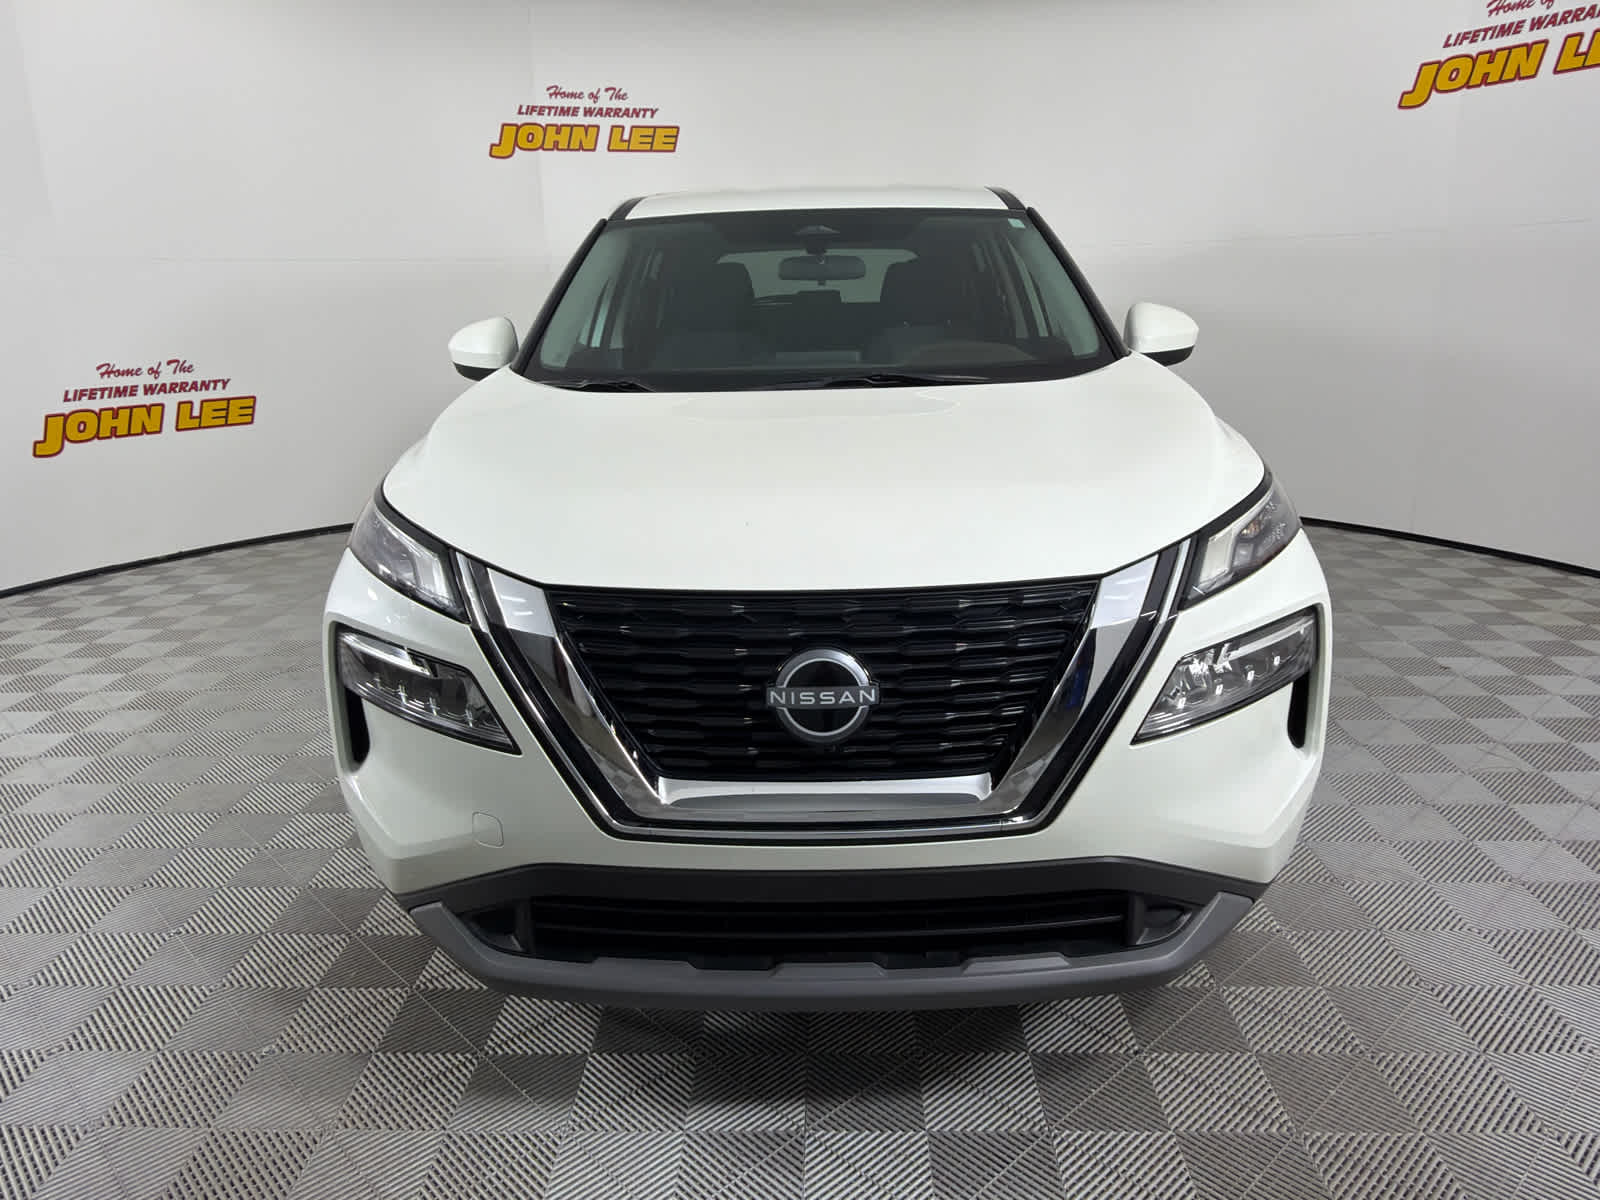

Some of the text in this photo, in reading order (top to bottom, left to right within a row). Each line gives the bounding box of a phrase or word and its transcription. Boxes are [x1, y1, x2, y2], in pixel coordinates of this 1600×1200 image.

[1442, 4, 1600, 48] LIFETIME WARRA
[1397, 39, 1549, 110] JOHN
[546, 84, 629, 103] Home of The
[517, 104, 659, 119] LIFETIME WARRANTY
[489, 122, 680, 159] JOHN LEE
[96, 358, 194, 380] Home of The
[63, 378, 231, 402] LIFETIME WARRANTY
[32, 396, 257, 458] JOHN LEE
[770, 688, 876, 705] NISSAN
